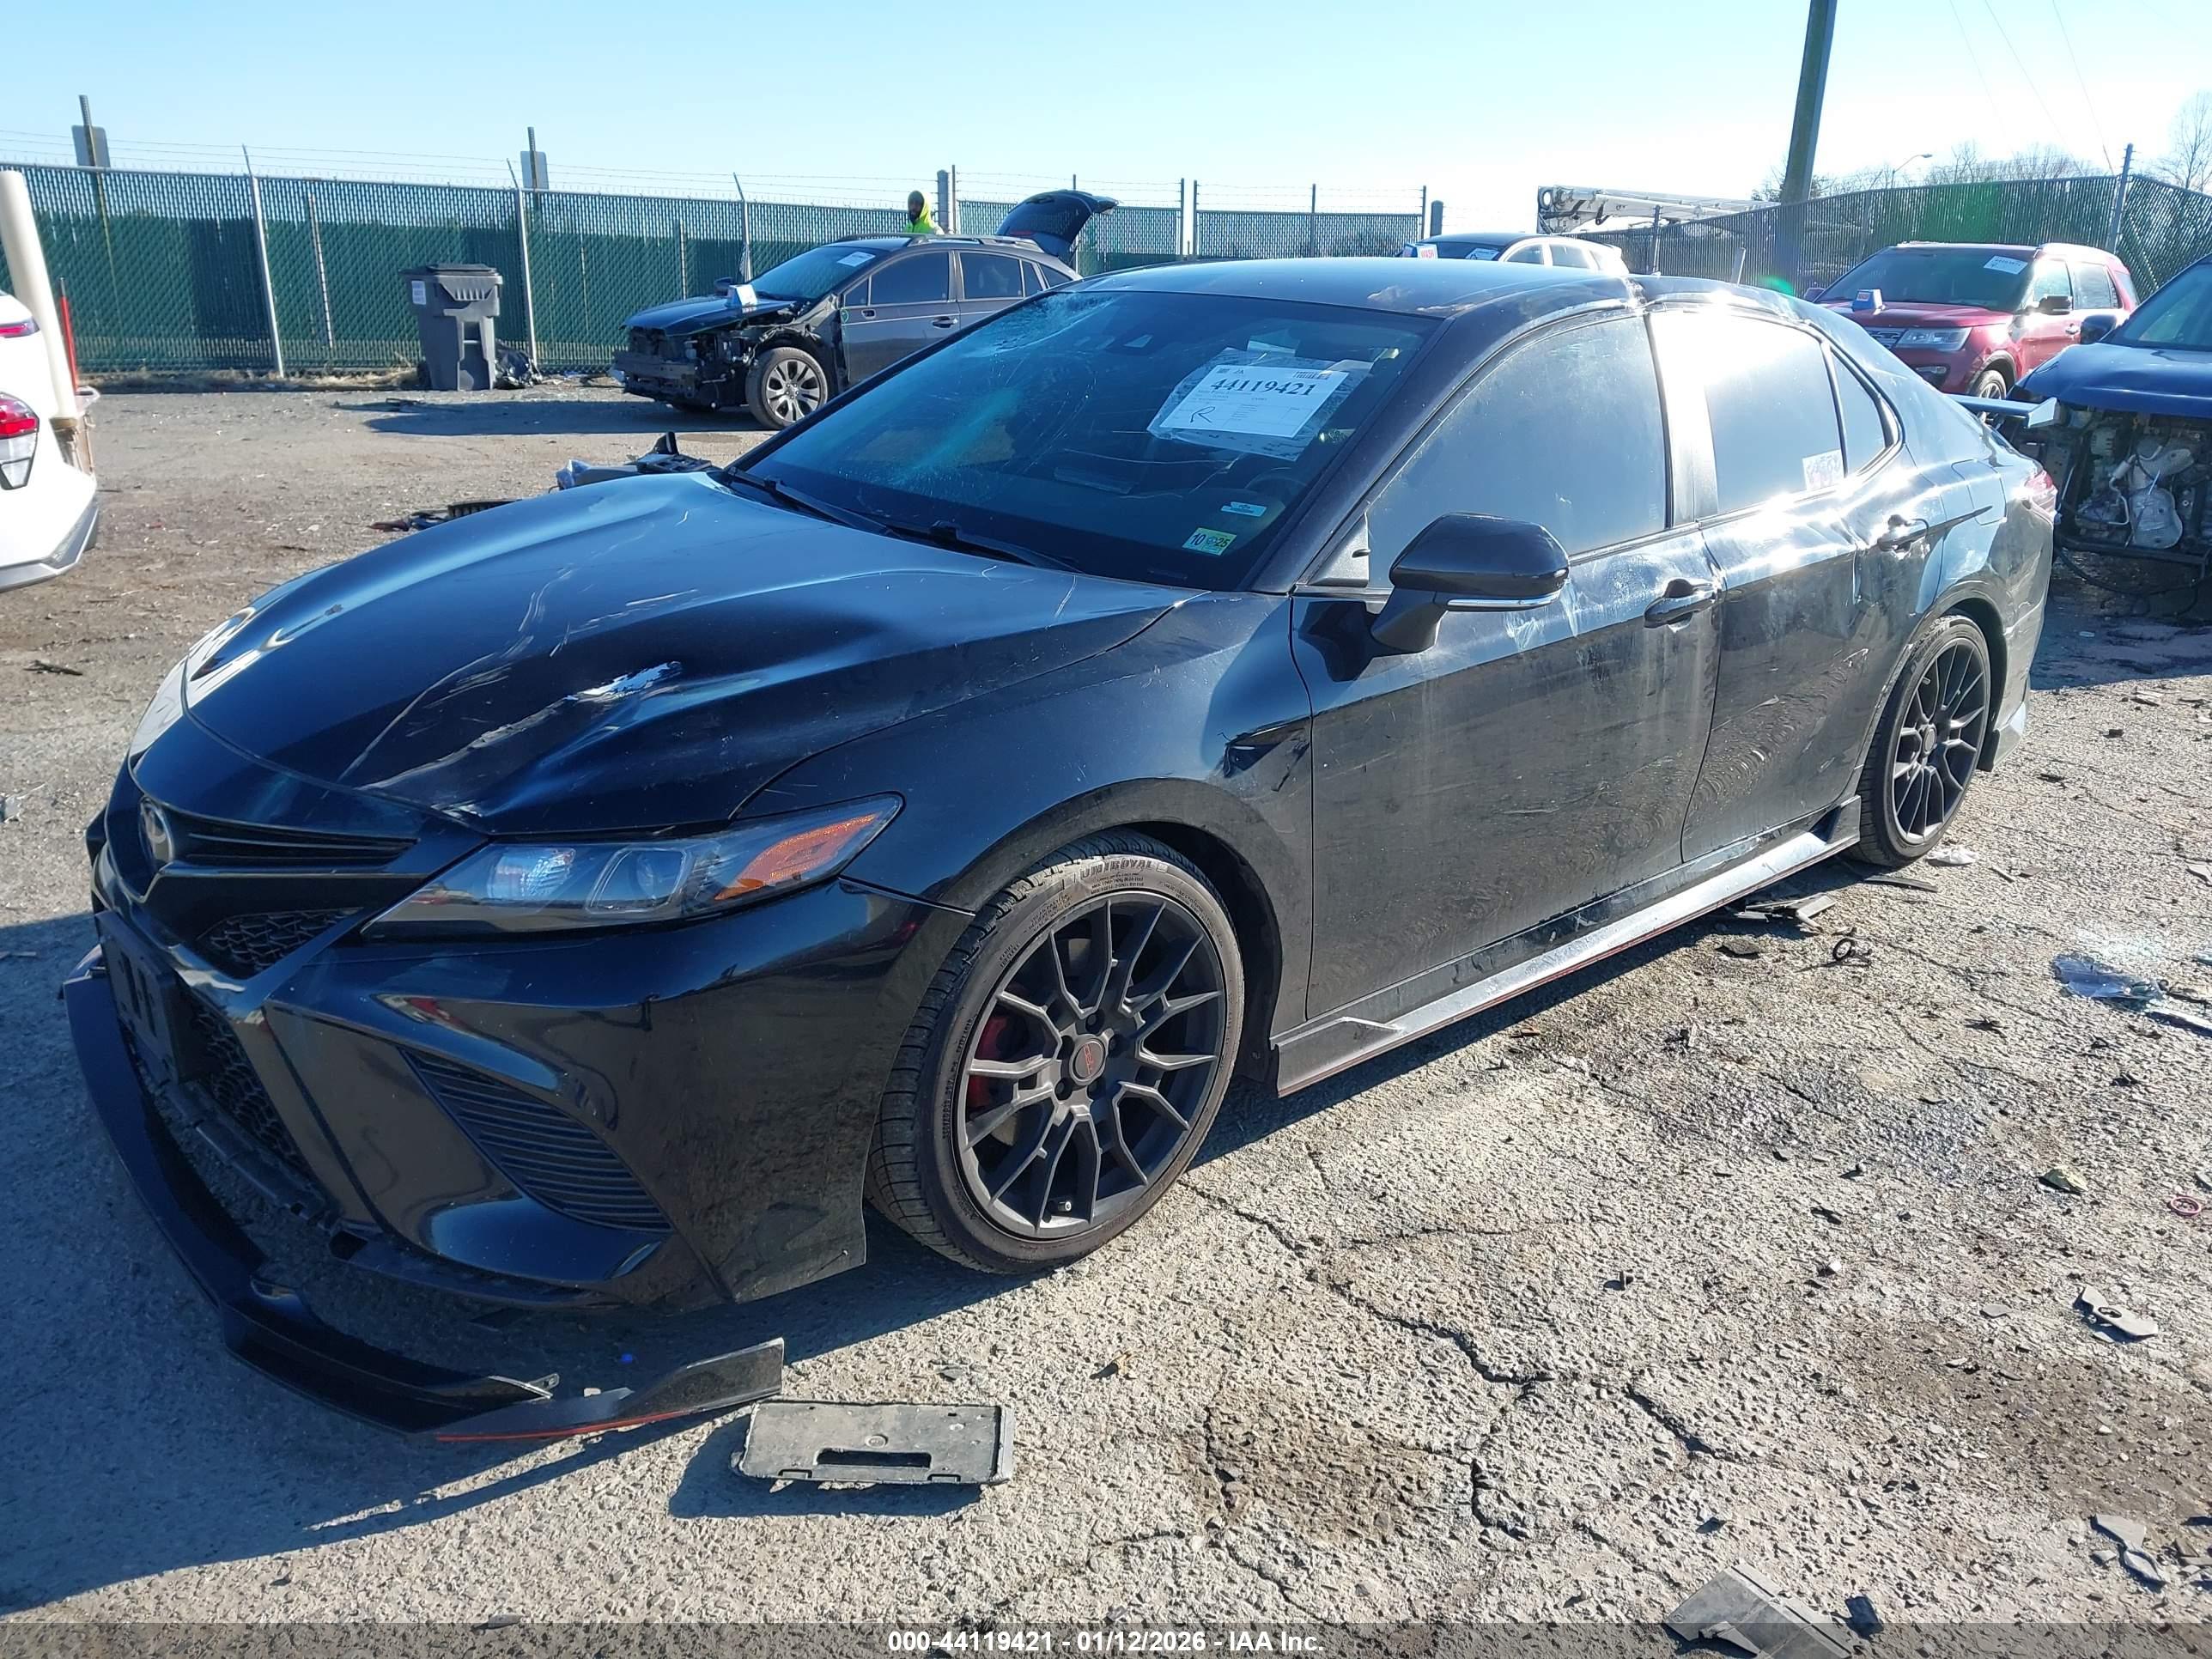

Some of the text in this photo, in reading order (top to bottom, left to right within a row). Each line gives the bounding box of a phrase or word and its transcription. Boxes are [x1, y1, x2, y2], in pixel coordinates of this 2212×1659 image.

[1210, 378, 1316, 396] 44119421
[1190, 405, 1216, 424] R
[1190, 533, 1206, 546] 10
[1215, 537, 1231, 548] 25
